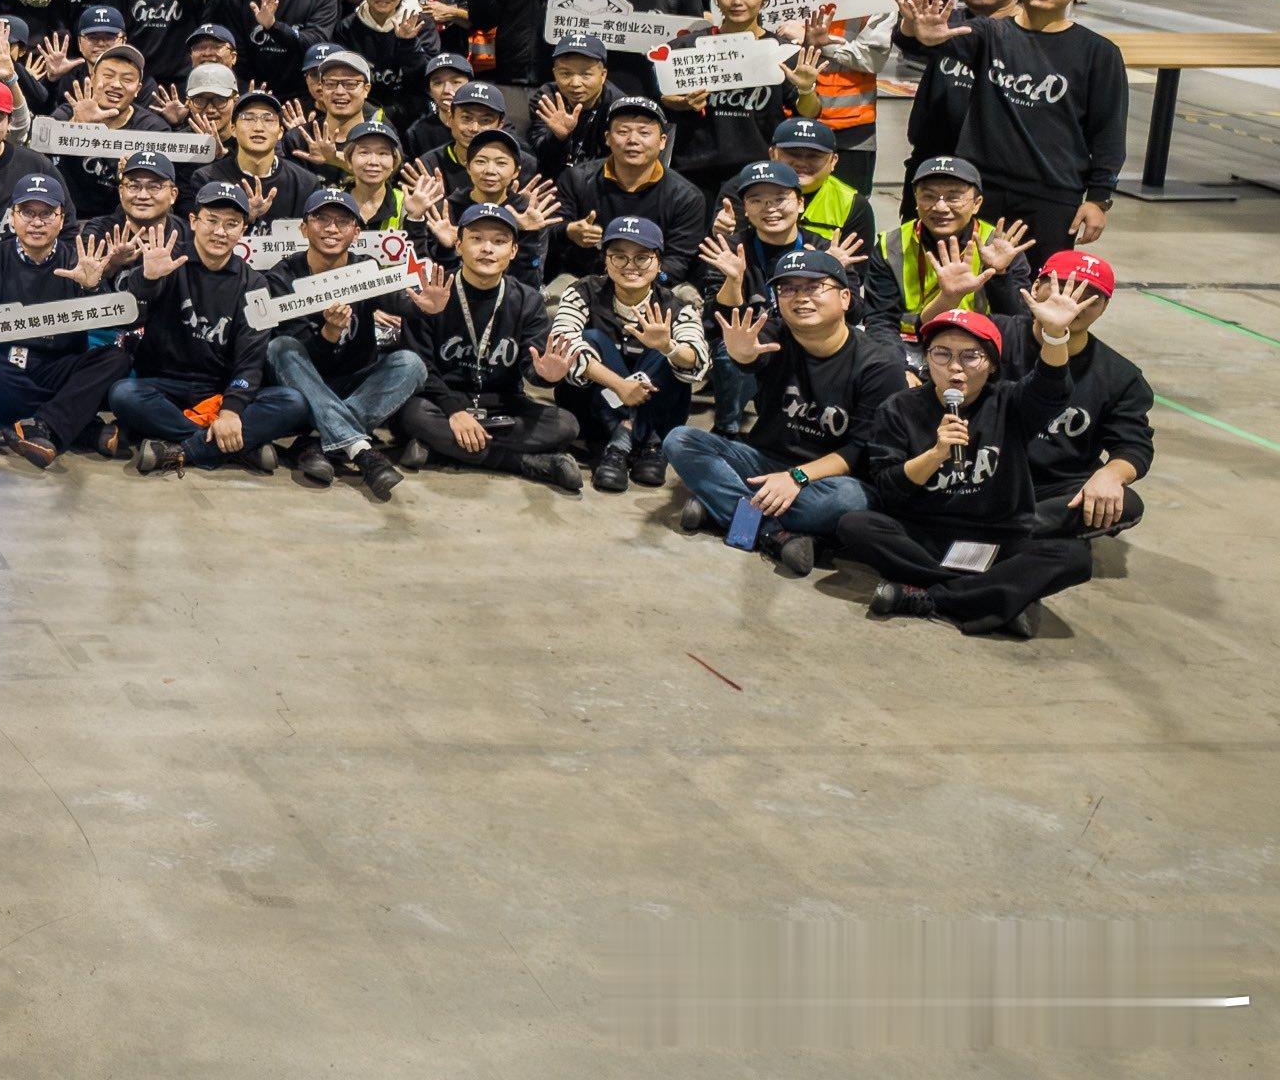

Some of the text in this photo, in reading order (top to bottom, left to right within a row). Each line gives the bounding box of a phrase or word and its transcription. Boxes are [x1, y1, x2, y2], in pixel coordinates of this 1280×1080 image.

[675, 72, 743, 89] 快乐并享受着
[58, 135, 211, 156] 我们力争在自己的领域做到最好
[278, 272, 402, 313] 我们力争在自己的领域做到最好
